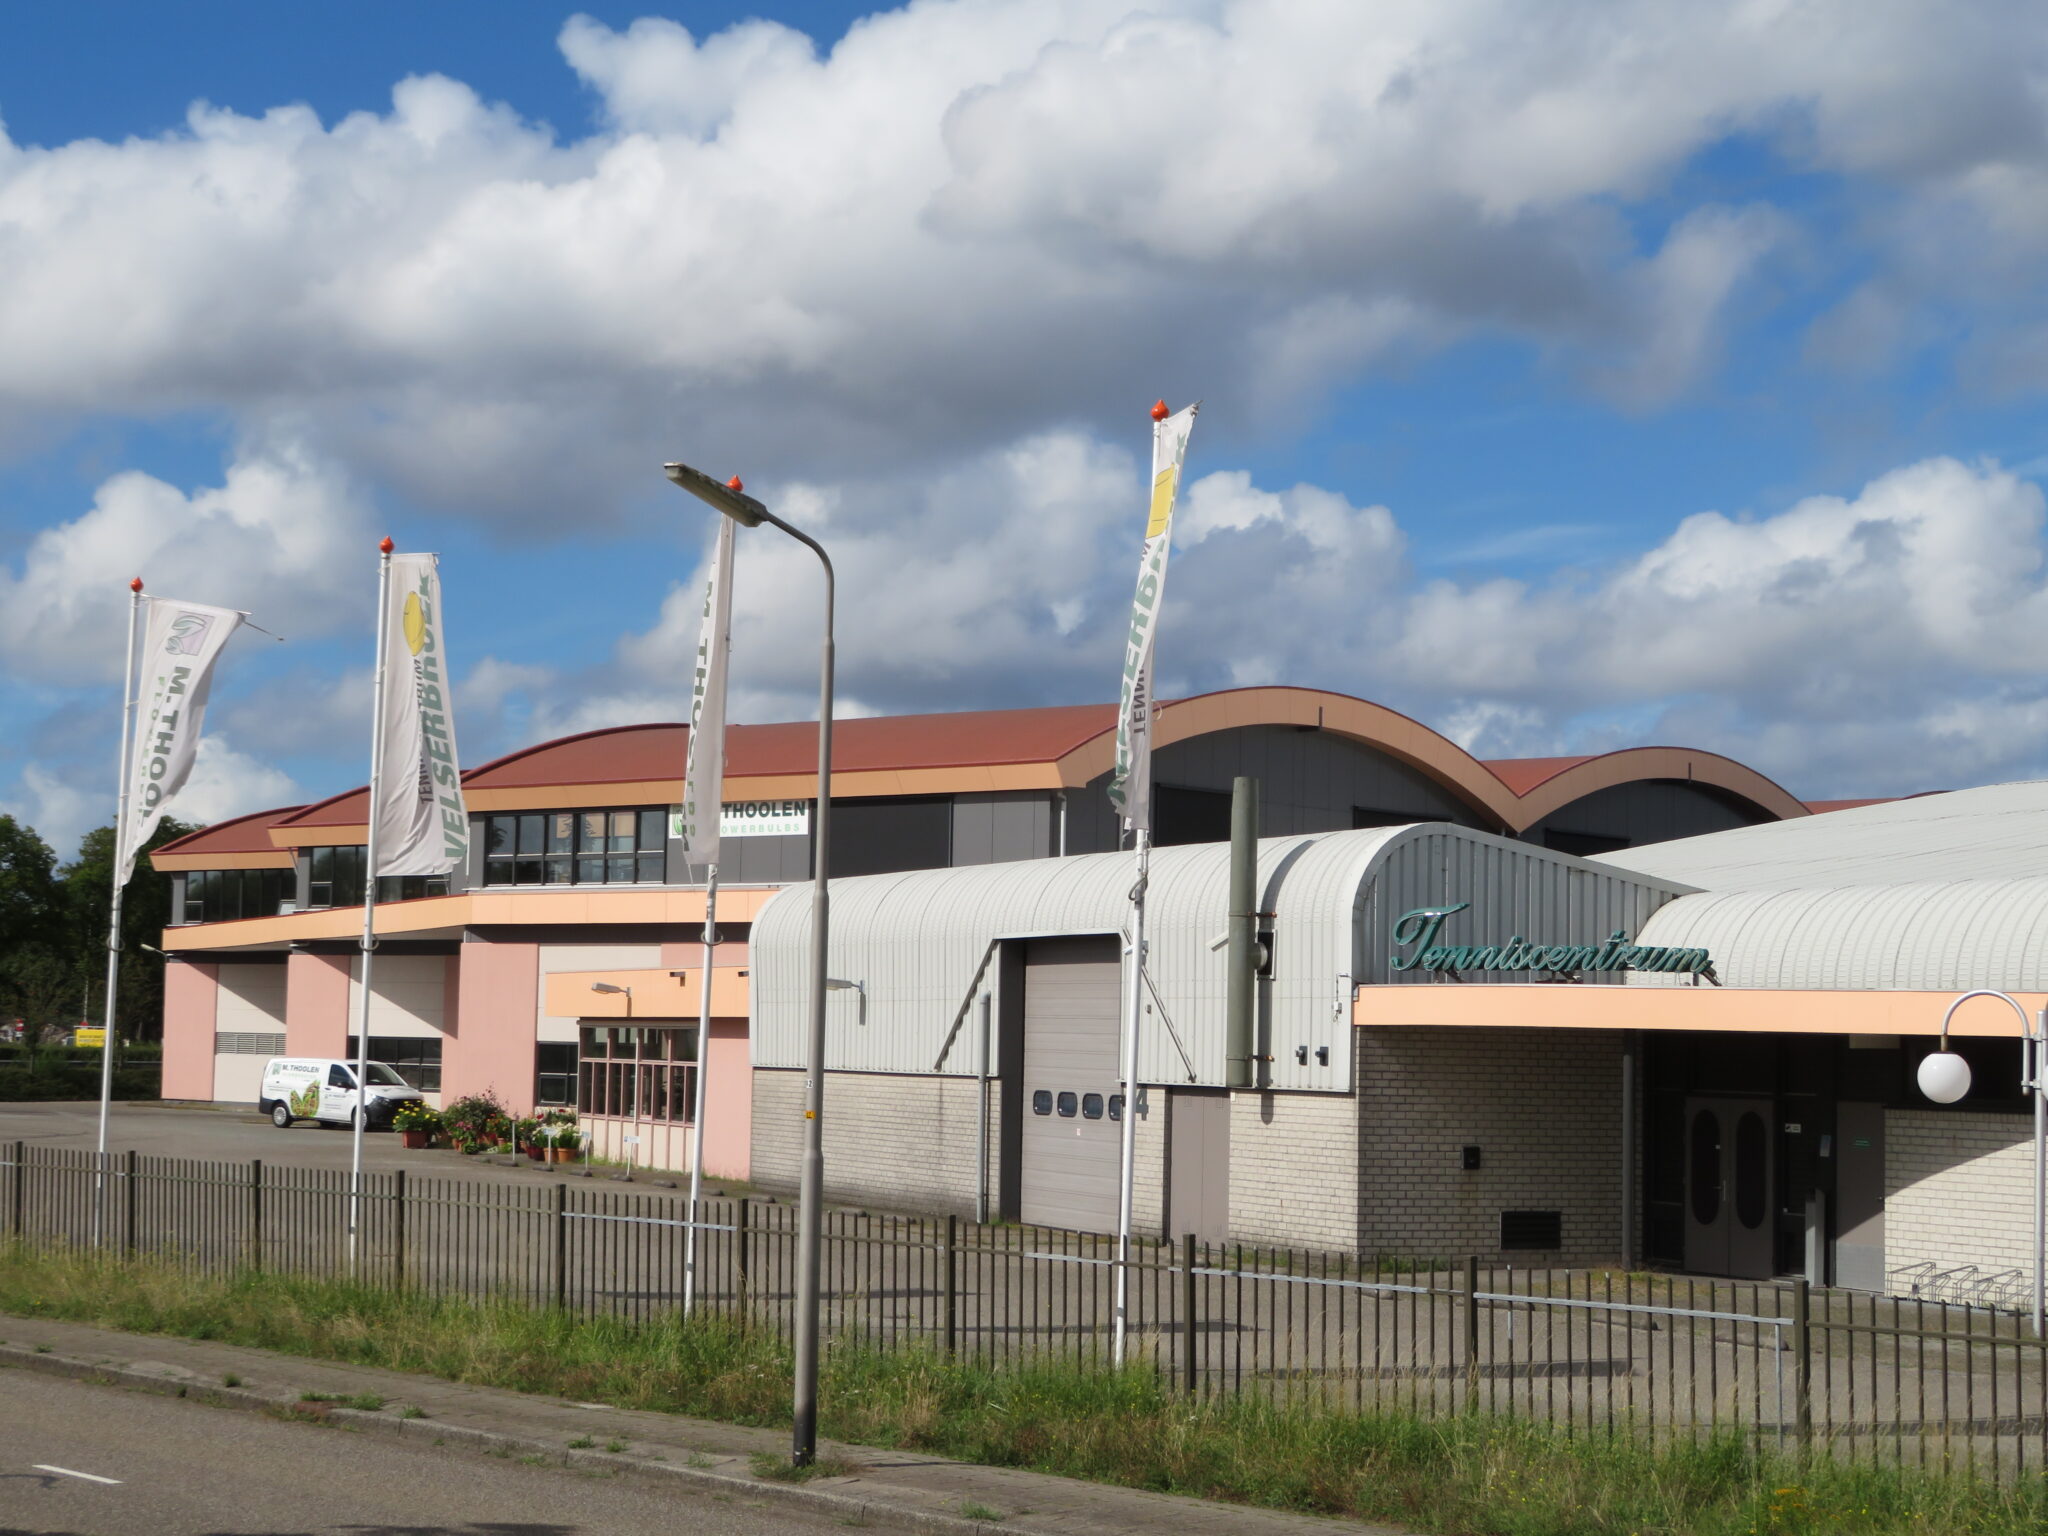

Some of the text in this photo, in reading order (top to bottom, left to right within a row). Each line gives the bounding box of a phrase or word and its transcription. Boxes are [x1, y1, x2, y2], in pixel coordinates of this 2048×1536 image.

[721, 801, 806, 819] THOOLEN
[721, 823, 801, 835] OWERBULBS
[1391, 902, 1714, 973] Tenniscentrum
